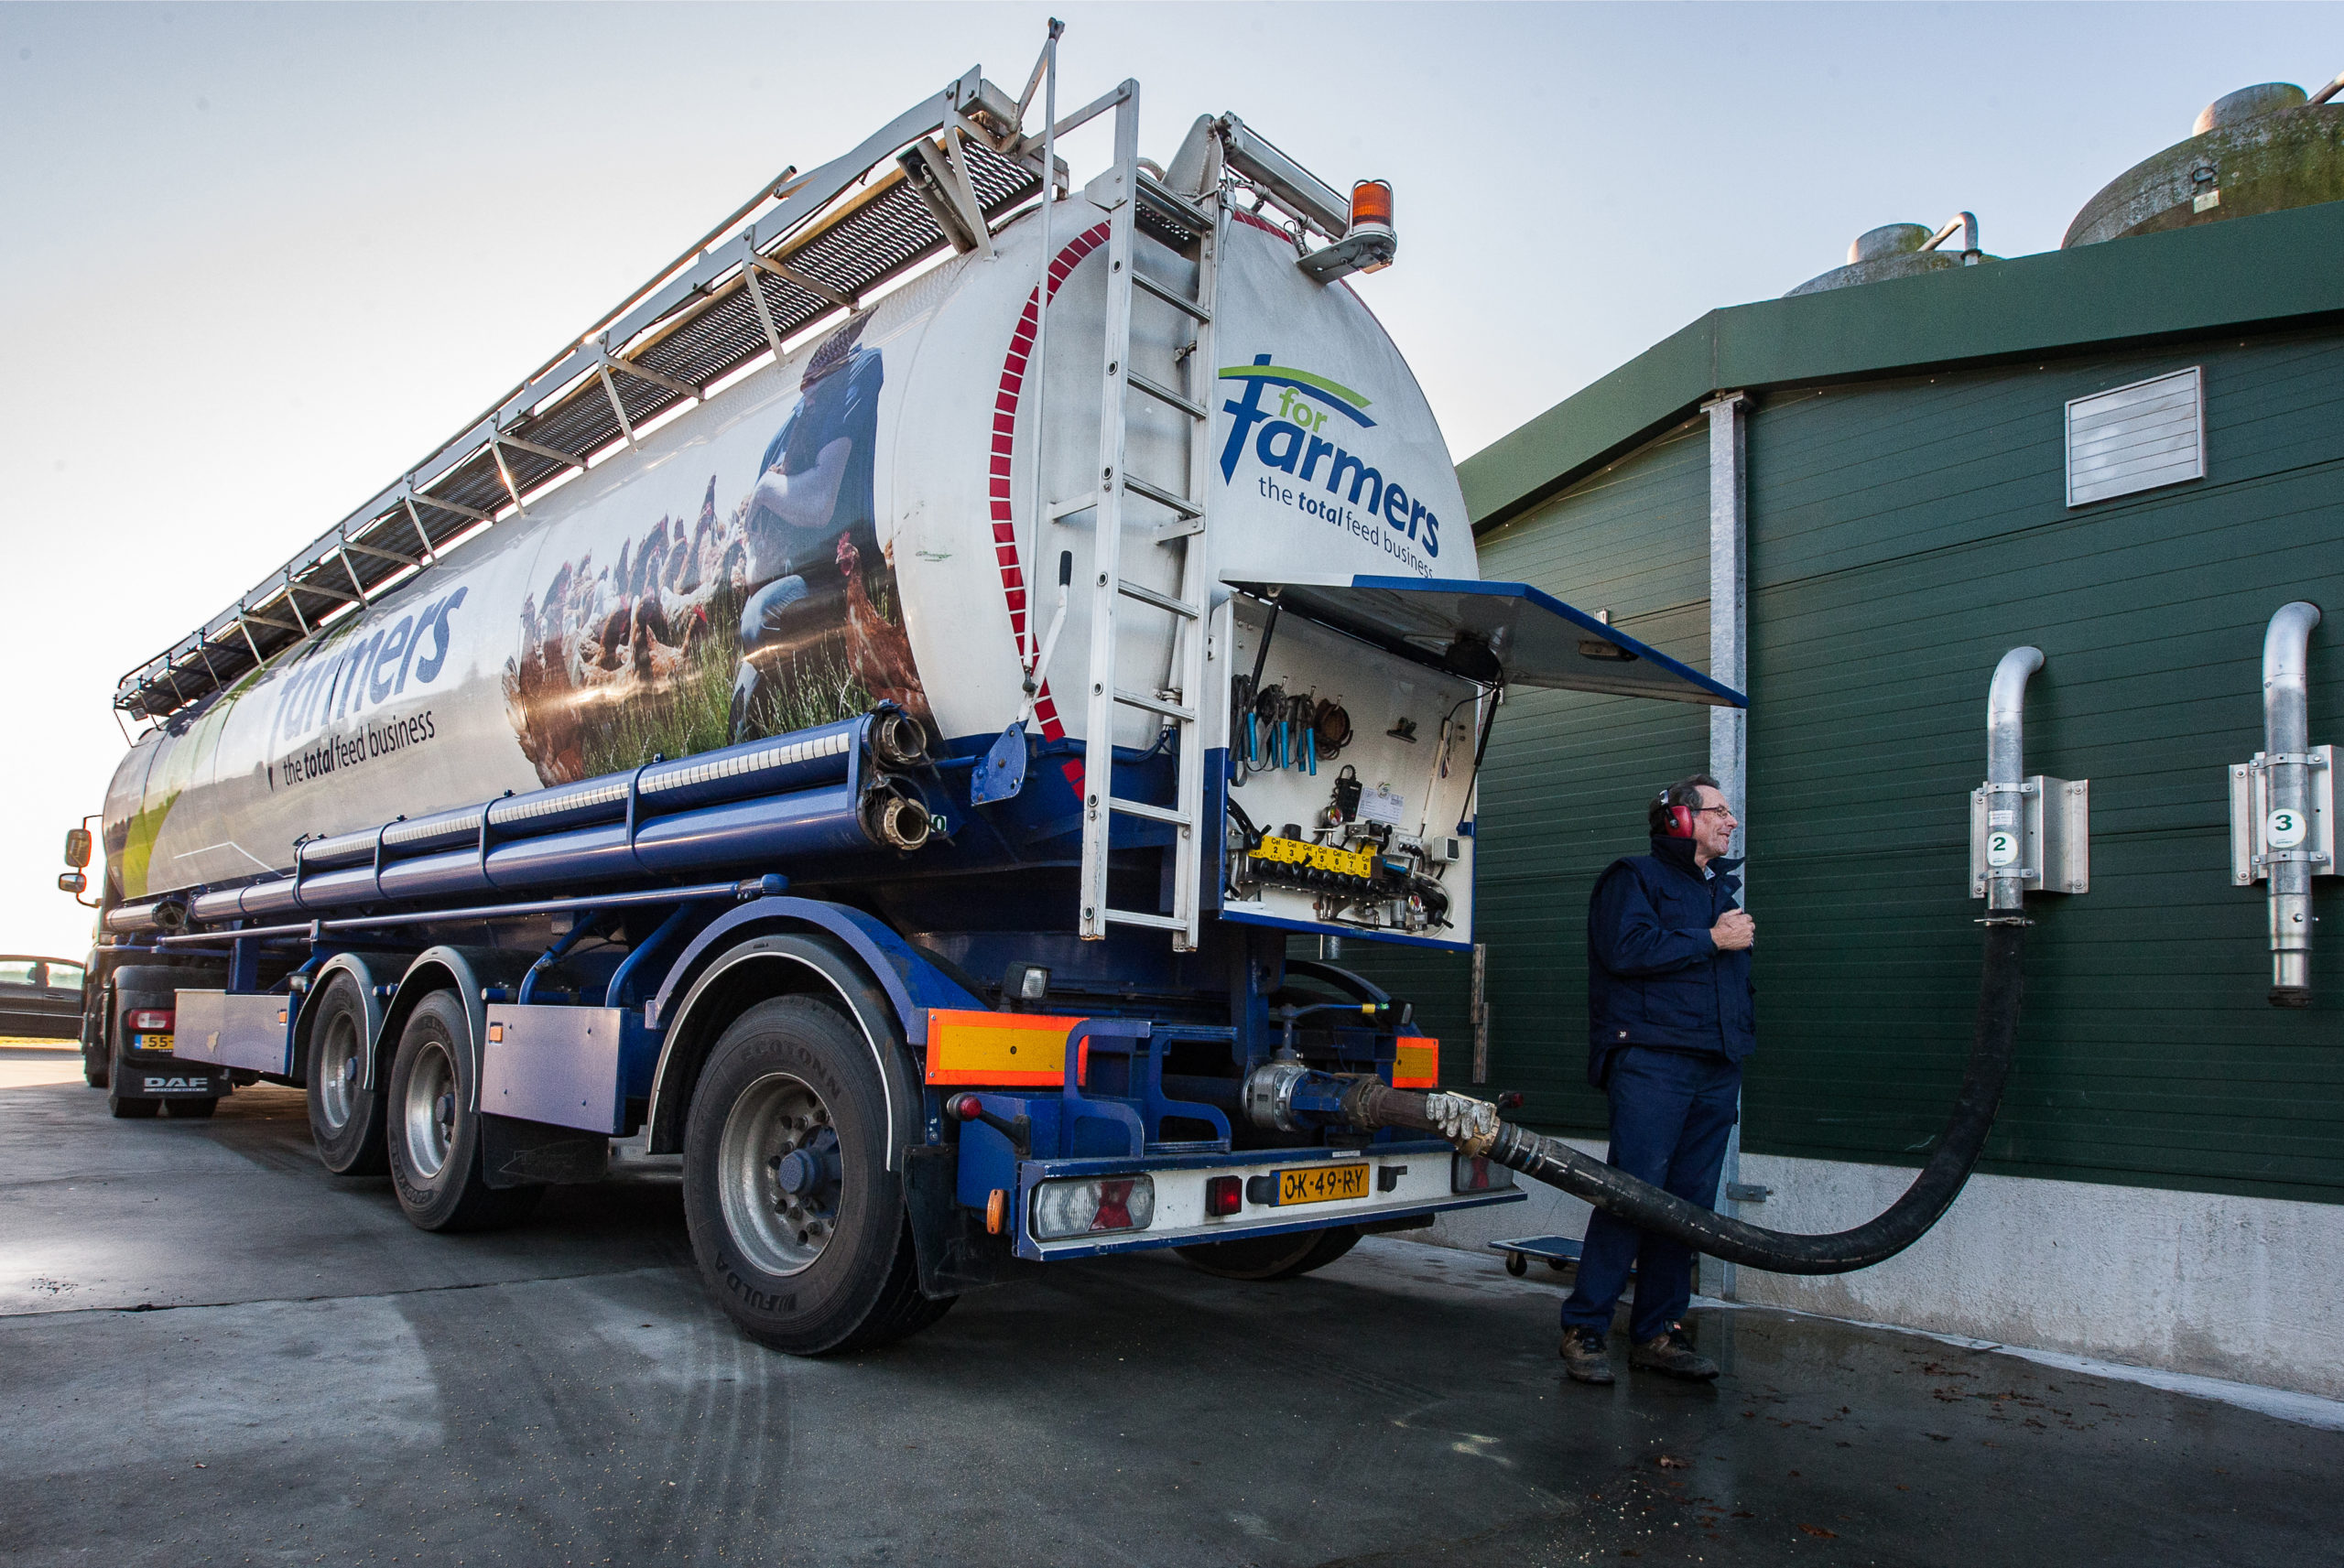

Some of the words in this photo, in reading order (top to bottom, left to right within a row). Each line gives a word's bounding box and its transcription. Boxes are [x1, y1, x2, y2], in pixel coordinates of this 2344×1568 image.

[1278, 387, 1328, 433] for
[1258, 476, 1293, 505] the
[1298, 492, 1343, 526] total
[1346, 510, 1379, 546] feed
[1384, 531, 1433, 579] business
[283, 754, 303, 786] the
[304, 738, 335, 779] total
[335, 726, 366, 769] feed
[367, 710, 435, 758] business
[2275, 814, 2293, 831] 3
[1289, 849, 1295, 857] 3
[1992, 836, 2006, 851] 2
[144, 1077, 208, 1087] DAF
[1285, 1168, 1364, 1200] OK-49-RY
[715, 1250, 773, 1313] FULDA
